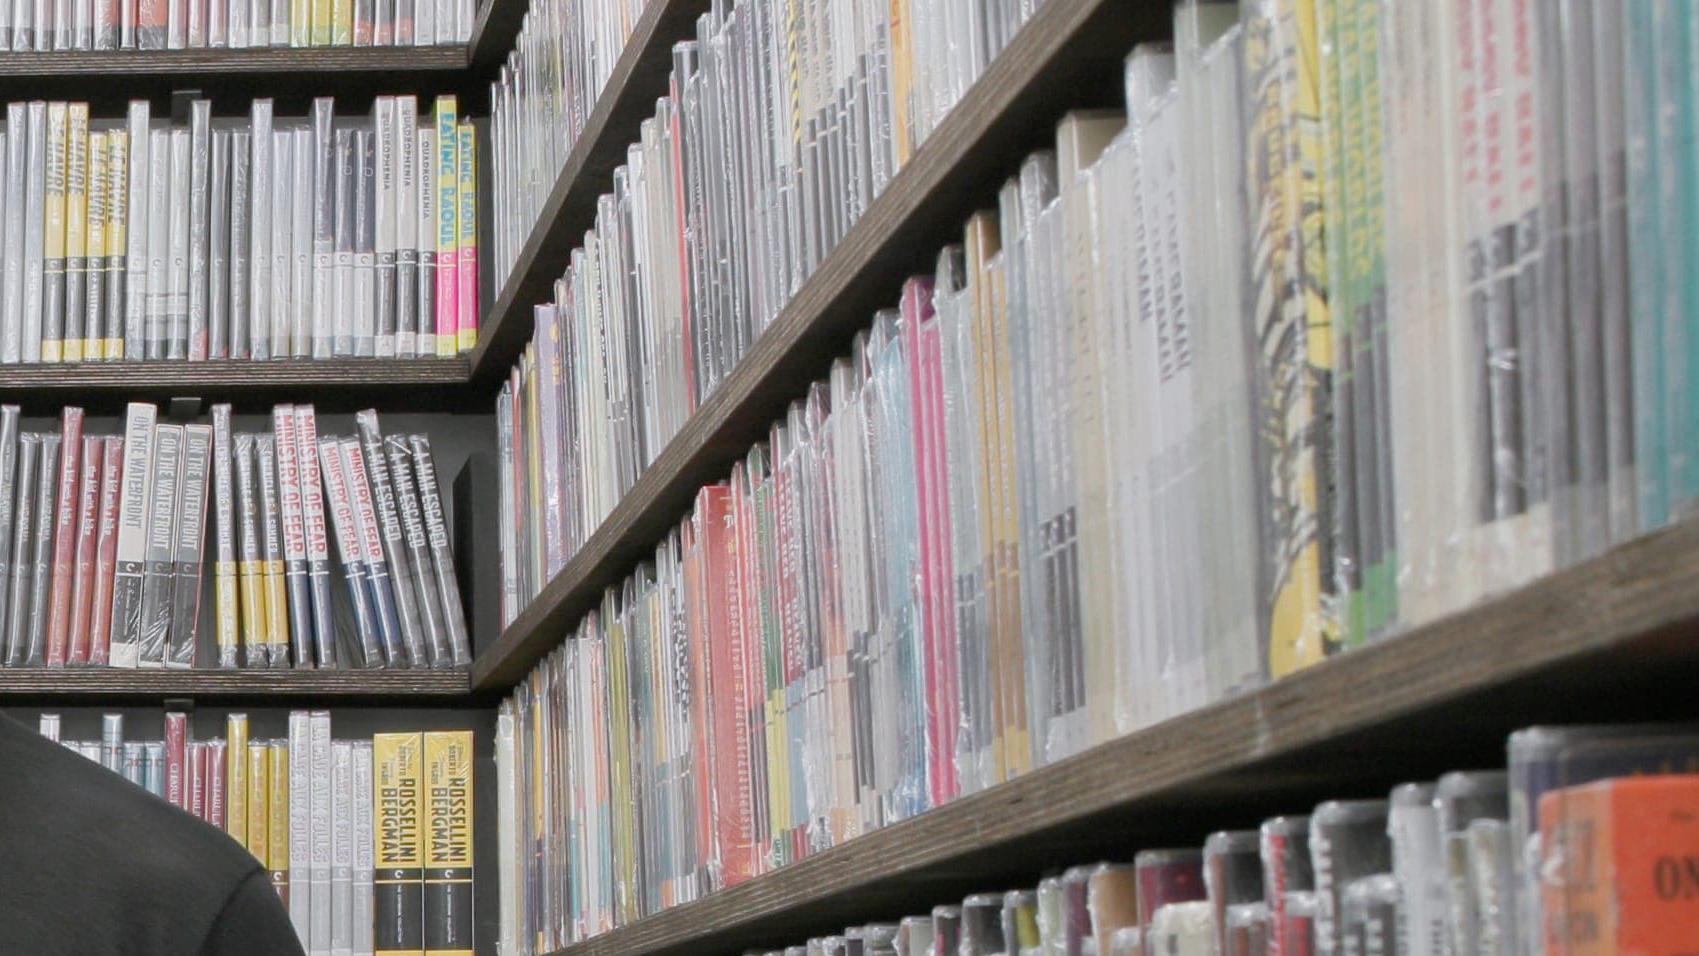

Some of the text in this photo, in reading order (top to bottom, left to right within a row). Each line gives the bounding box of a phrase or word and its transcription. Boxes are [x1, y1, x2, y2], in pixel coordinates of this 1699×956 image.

[421, 141, 431, 220] QUADROPHENIA
[439, 113, 454, 246] EATING RAOUL
[459, 132, 472, 184] EATING
[124, 416, 149, 529] ON THE WATERFRONT
[152, 438, 173, 550] ON THE WATERFRONT
[181, 438, 203, 550] ON THE WATERFRONT
[276, 414, 303, 554] MINISTRY OF FEAR
[305, 493, 320, 511] OF
[348, 448, 369, 506] MINISTRY
[414, 464, 434, 493] MAN
[267, 520, 278, 554] SUMMER
[307, 515, 325, 554] FEAR
[422, 496, 447, 549] ESCAPED
[311, 816, 326, 863] FOLLES
[379, 788, 397, 863] BERGMAN
[398, 778, 416, 863] ROSSELLINI
[430, 788, 448, 863] BERGMAN
[448, 778, 466, 863] ROSSELLINI
